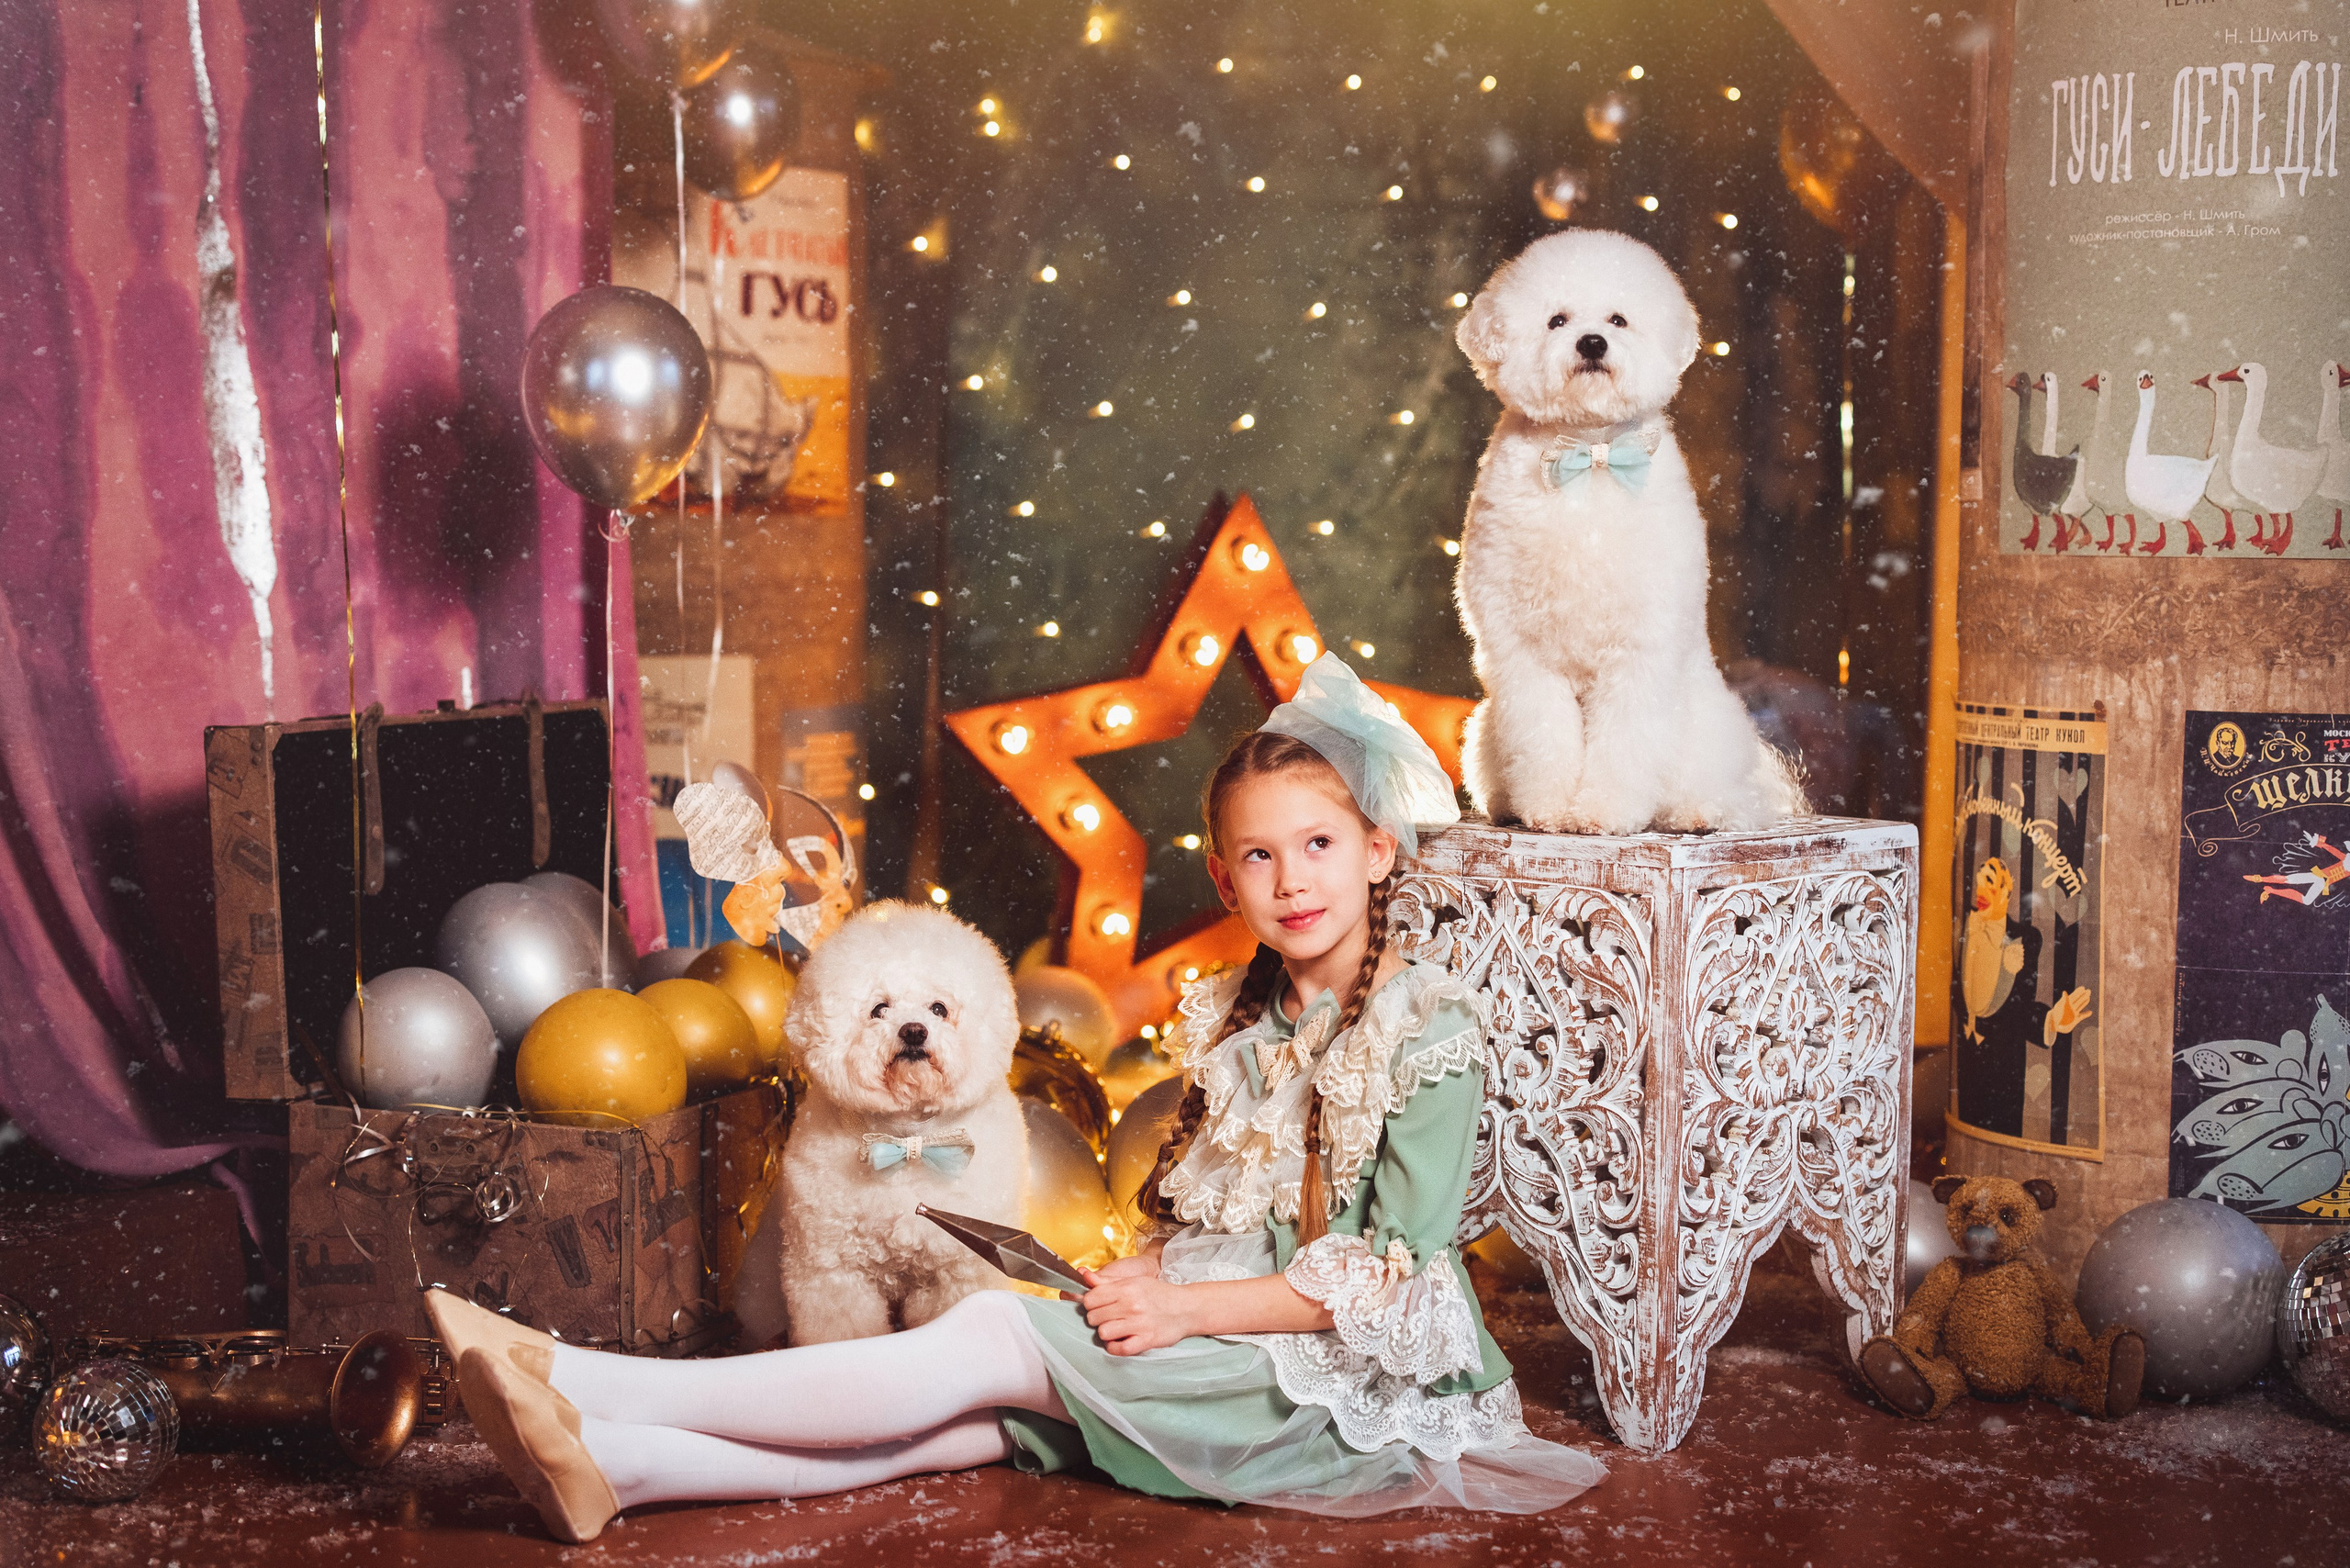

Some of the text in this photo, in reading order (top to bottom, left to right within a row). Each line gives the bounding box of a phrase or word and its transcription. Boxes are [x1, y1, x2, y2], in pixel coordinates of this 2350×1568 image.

[2225, 28, 2319, 44] Н. Шмить
[2049, 60, 2342, 198] ГУСИ ЛЕБЕДИ
[2105, 210, 2172, 226] режиссёр
[2183, 210, 2195, 220] Н.
[2199, 209, 2245, 220] Шмить
[2226, 225, 2241, 236] А.
[2244, 224, 2281, 237] Гром
[2026, 724, 2050, 742] ТЕАТР
[2055, 728, 2086, 744] КУКОЛ
